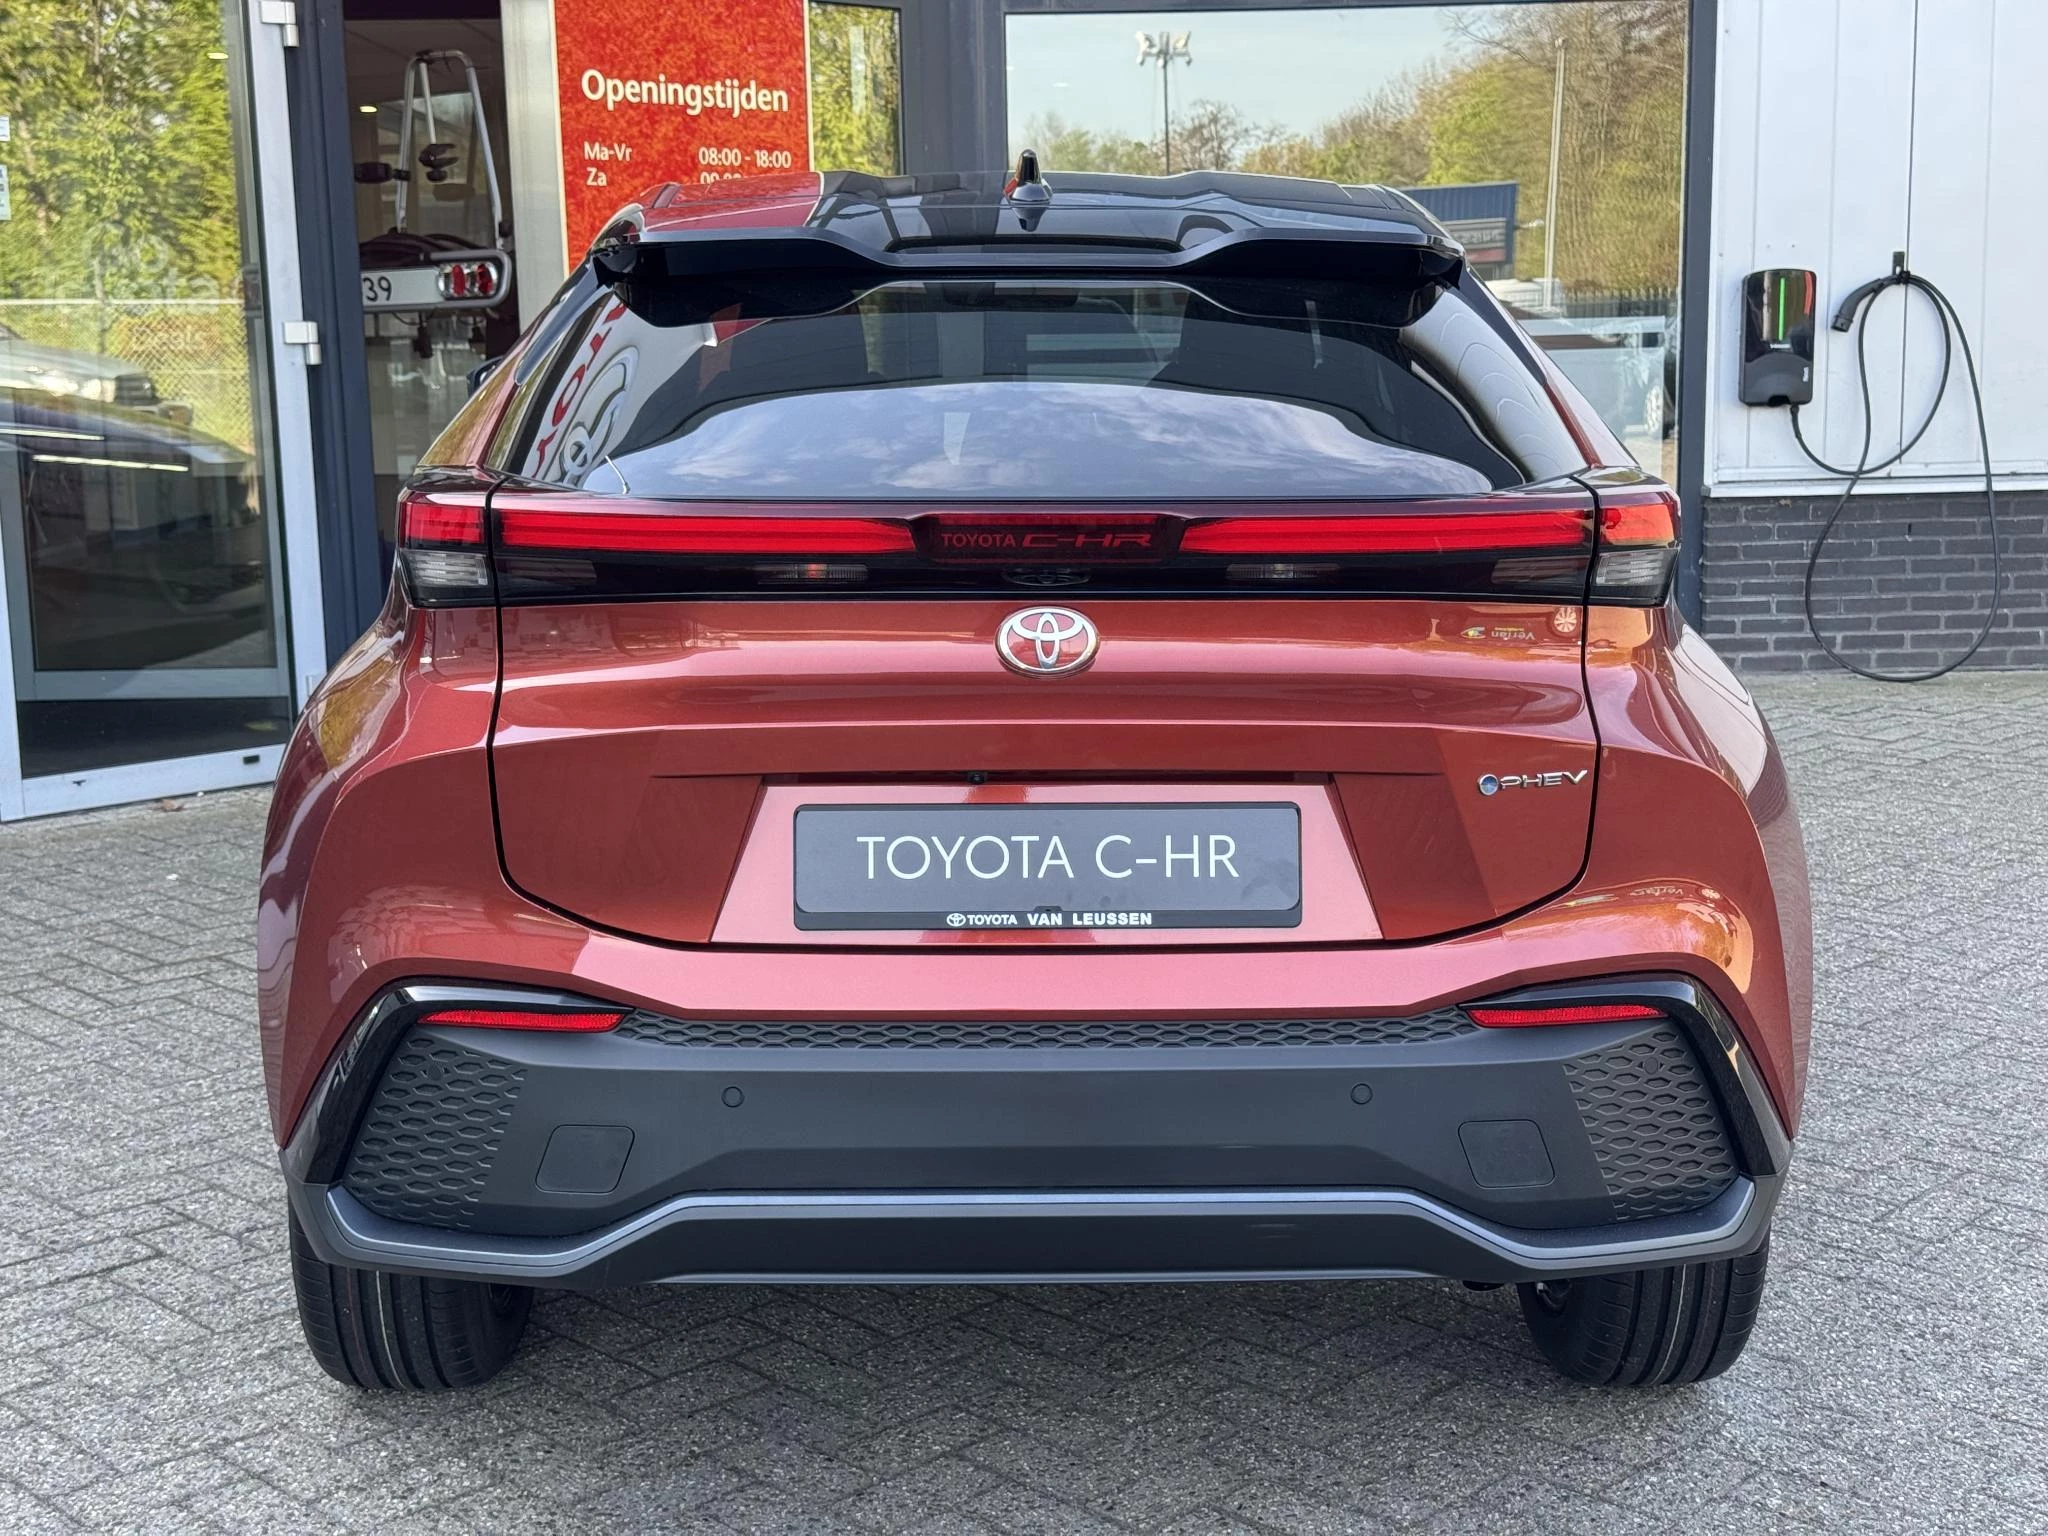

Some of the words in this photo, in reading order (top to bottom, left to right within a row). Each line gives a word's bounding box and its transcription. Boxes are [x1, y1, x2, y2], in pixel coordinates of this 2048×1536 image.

[581, 69, 789, 117] Openingstijden
[584, 141, 632, 162] Ma-Vr
[699, 147, 741, 167] 08:00
[755, 150, 791, 168] 18:00
[587, 167, 607, 187] Za
[363, 276, 392, 302] 39
[941, 533, 1016, 548] TOYOTA
[1023, 533, 1152, 548] C-HR
[1501, 770, 1588, 788] PHEV
[857, 836, 1074, 880] TOYOTA
[1096, 836, 1240, 878] C-HR
[967, 915, 1018, 926] TOYOTA
[1027, 914, 1063, 925] VAN
[1073, 914, 1153, 925] LEUSSEN
